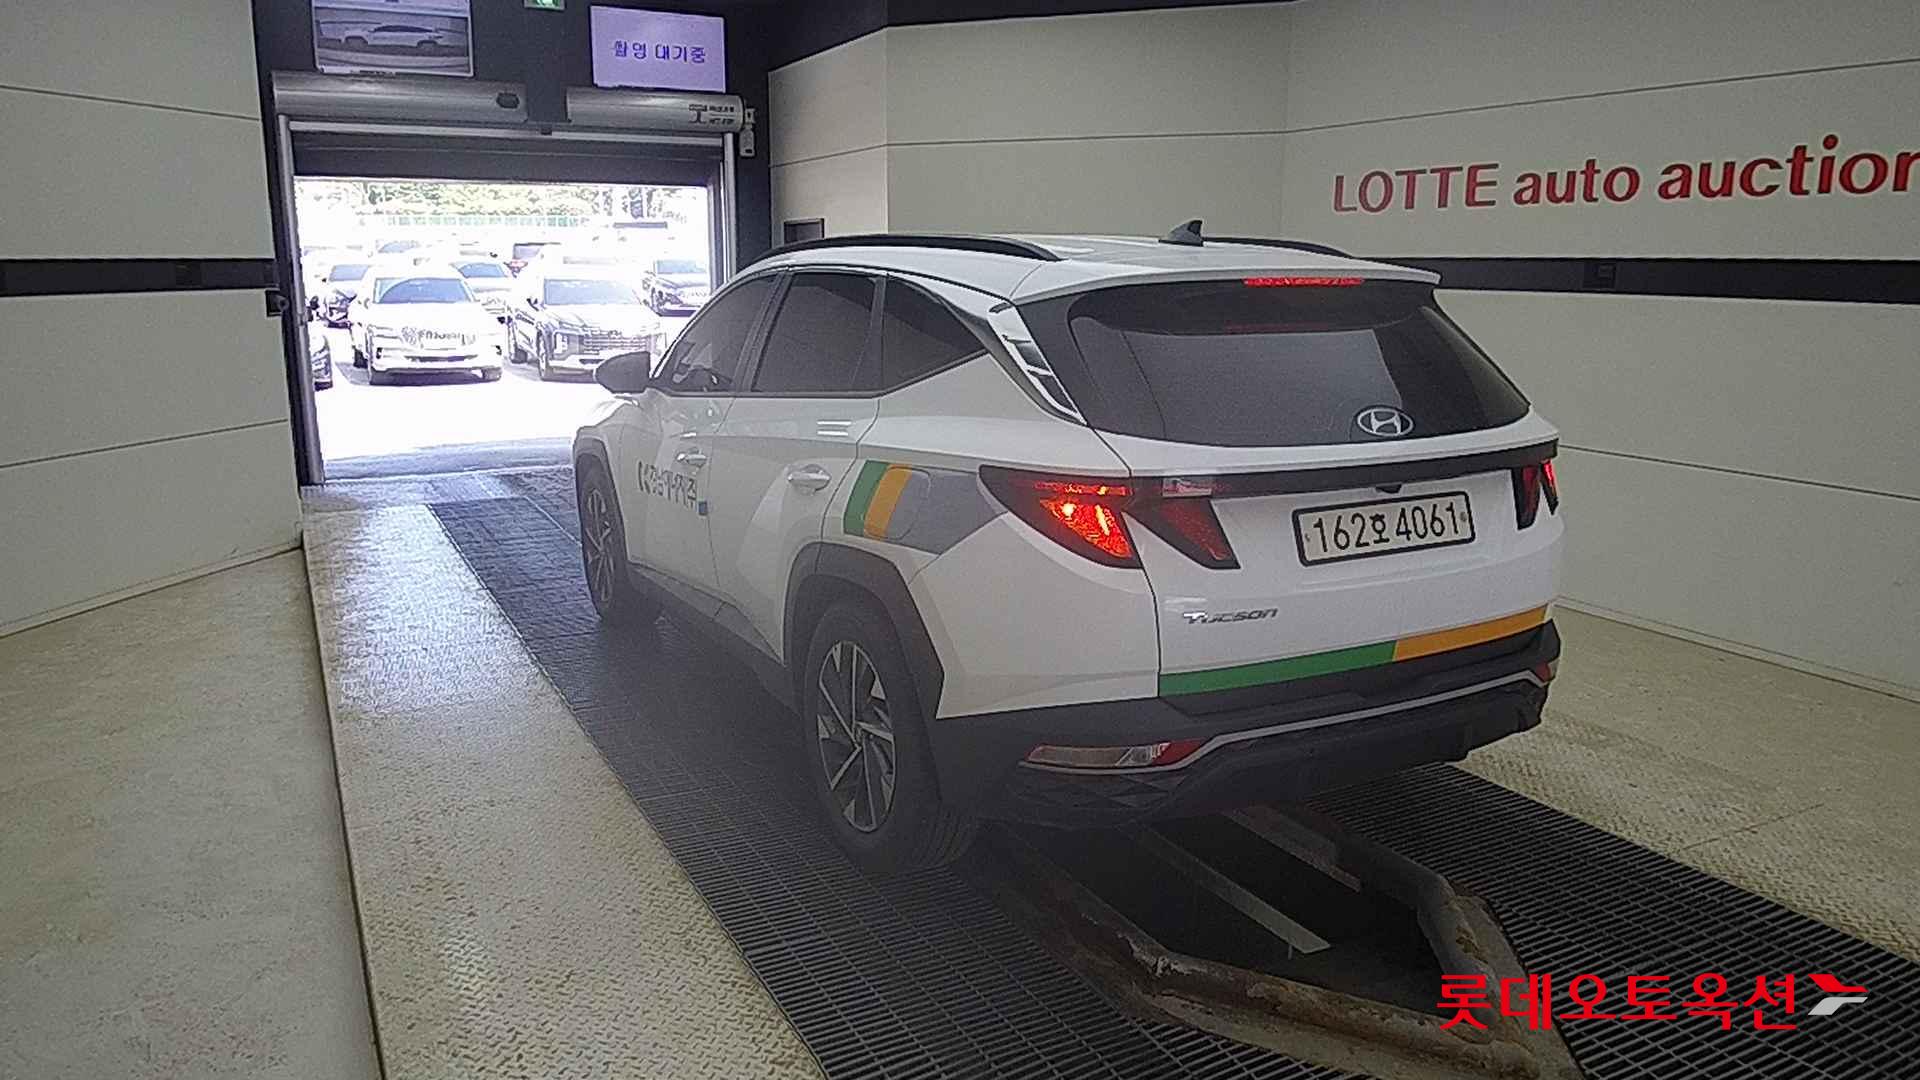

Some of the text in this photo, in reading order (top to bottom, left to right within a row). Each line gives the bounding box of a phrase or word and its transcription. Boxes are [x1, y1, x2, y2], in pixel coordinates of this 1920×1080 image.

[1333, 163, 1499, 213] LOTTE
[1513, 158, 1640, 206] auto
[1313, 501, 1460, 553] 162호 4061
